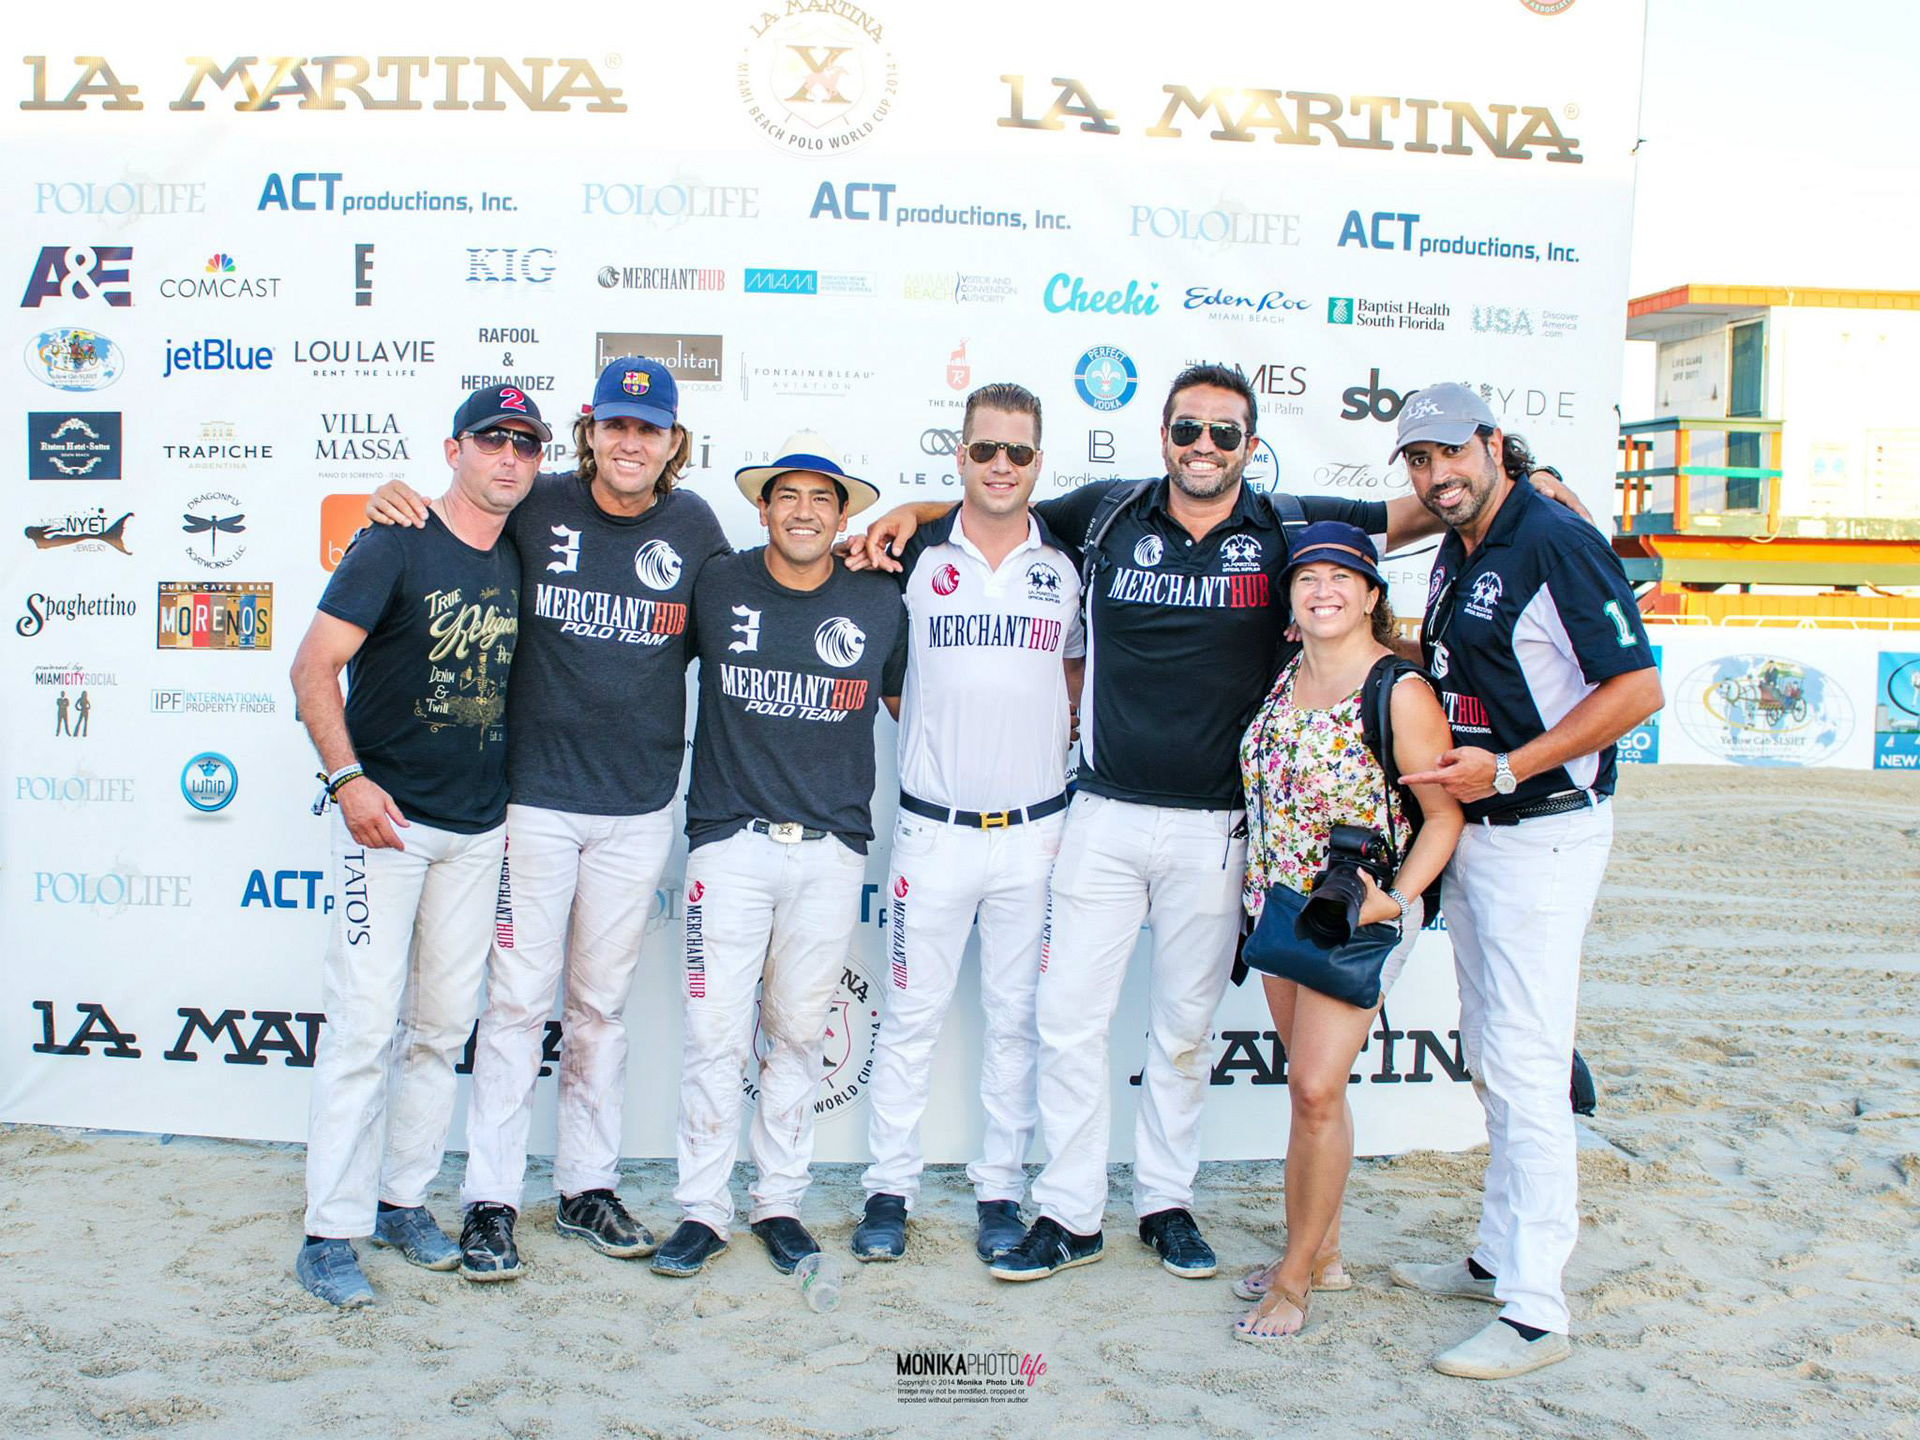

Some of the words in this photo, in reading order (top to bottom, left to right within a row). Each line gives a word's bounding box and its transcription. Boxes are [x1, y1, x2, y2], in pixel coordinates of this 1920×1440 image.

[749, 11, 779, 39] LA
[20, 56, 144, 111] LA
[168, 56, 628, 113] MARTINA
[736, 61, 754, 104] MIAMI
[749, 106, 786, 141] BEACH
[788, 133, 824, 150] POLO
[828, 121, 875, 150] WORLD
[872, 97, 892, 122] CUP
[885, 62, 898, 95] 2014
[997, 74, 1121, 136] LA
[1145, 84, 1583, 164] MARTINA
[257, 172, 343, 211] ACT
[342, 191, 473, 216] productions,
[481, 191, 518, 212] Inc.
[809, 180, 897, 222] ACT
[896, 203, 1028, 231] productions,
[1035, 208, 1073, 231] Inc.
[1337, 209, 1421, 252] ACT
[1419, 233, 1540, 264] productions,
[1547, 241, 1580, 263] Inc.
[20, 246, 134, 308] A&E
[160, 278, 281, 298] COMCAST
[622, 267, 725, 292] MERCHANTHUB
[1043, 273, 1159, 316] Cheeki
[1183, 287, 1256, 310] Eden
[1256, 291, 1313, 313] Roc
[1208, 313, 1244, 322] MIAMI
[1249, 315, 1285, 324] BEACH
[1358, 299, 1403, 313] Baptist
[1408, 302, 1450, 316] Health
[1542, 311, 1578, 320] Discover
[1356, 313, 1394, 328] South
[1399, 317, 1445, 331] Florida
[1471, 305, 1534, 336] USA
[1542, 321, 1577, 330] America
[479, 328, 539, 344] RAFOOL
[164, 339, 273, 378] jetBlue
[502, 352, 514, 367] &
[1087, 346, 1128, 362] PERFECT
[500, 388, 527, 412] 2
[929, 400, 946, 408] THE
[1093, 398, 1123, 411] VODKA
[1275, 403, 1304, 416] Palm
[321, 413, 400, 434] VILLA
[163, 445, 273, 459] TRAPICHE
[315, 439, 410, 460] MASSA
[188, 462, 248, 470] ARGENTINA
[900, 473, 926, 485] LE
[187, 492, 242, 511] DRAGONFLY
[185, 547, 233, 570] BOATWORKS
[232, 545, 247, 562] LLC
[546, 524, 582, 574] 3
[1108, 567, 1271, 609] MERCHANTHUB
[16, 593, 137, 637] Spaghettino
[424, 588, 463, 619] TRUE
[535, 583, 687, 636] MERCHANTHUB
[161, 604, 268, 636] MORENOS
[728, 604, 761, 654] 3
[1603, 599, 1637, 648] 1
[560, 621, 615, 639] POLO
[618, 629, 670, 646] TEAM
[929, 614, 1062, 652] MERCHANTHUB
[186, 692, 276, 703] INTERNATIONAL
[434, 684, 449, 699] &
[720, 663, 869, 711] MERCHANTHUB
[155, 693, 182, 710] IPF
[186, 703, 236, 713] PROPERTY
[240, 703, 276, 713] FINDER
[745, 700, 796, 717] POLO
[798, 706, 849, 722] TEAM
[1452, 724, 1492, 734] PROCESSING
[1753, 736, 1772, 746] Cab
[1880, 754, 1919, 768] NEW
[192, 777, 225, 795] whip
[33, 872, 192, 908] POLOLIFE
[240, 869, 324, 909] ACT
[344, 849, 371, 946] TATO'S
[686, 905, 706, 998] MERCHANTHUB
[892, 899, 908, 990] MERCHANTHUB
[33, 1001, 141, 1058] LA
[814, 1084, 859, 1114] WORLD
